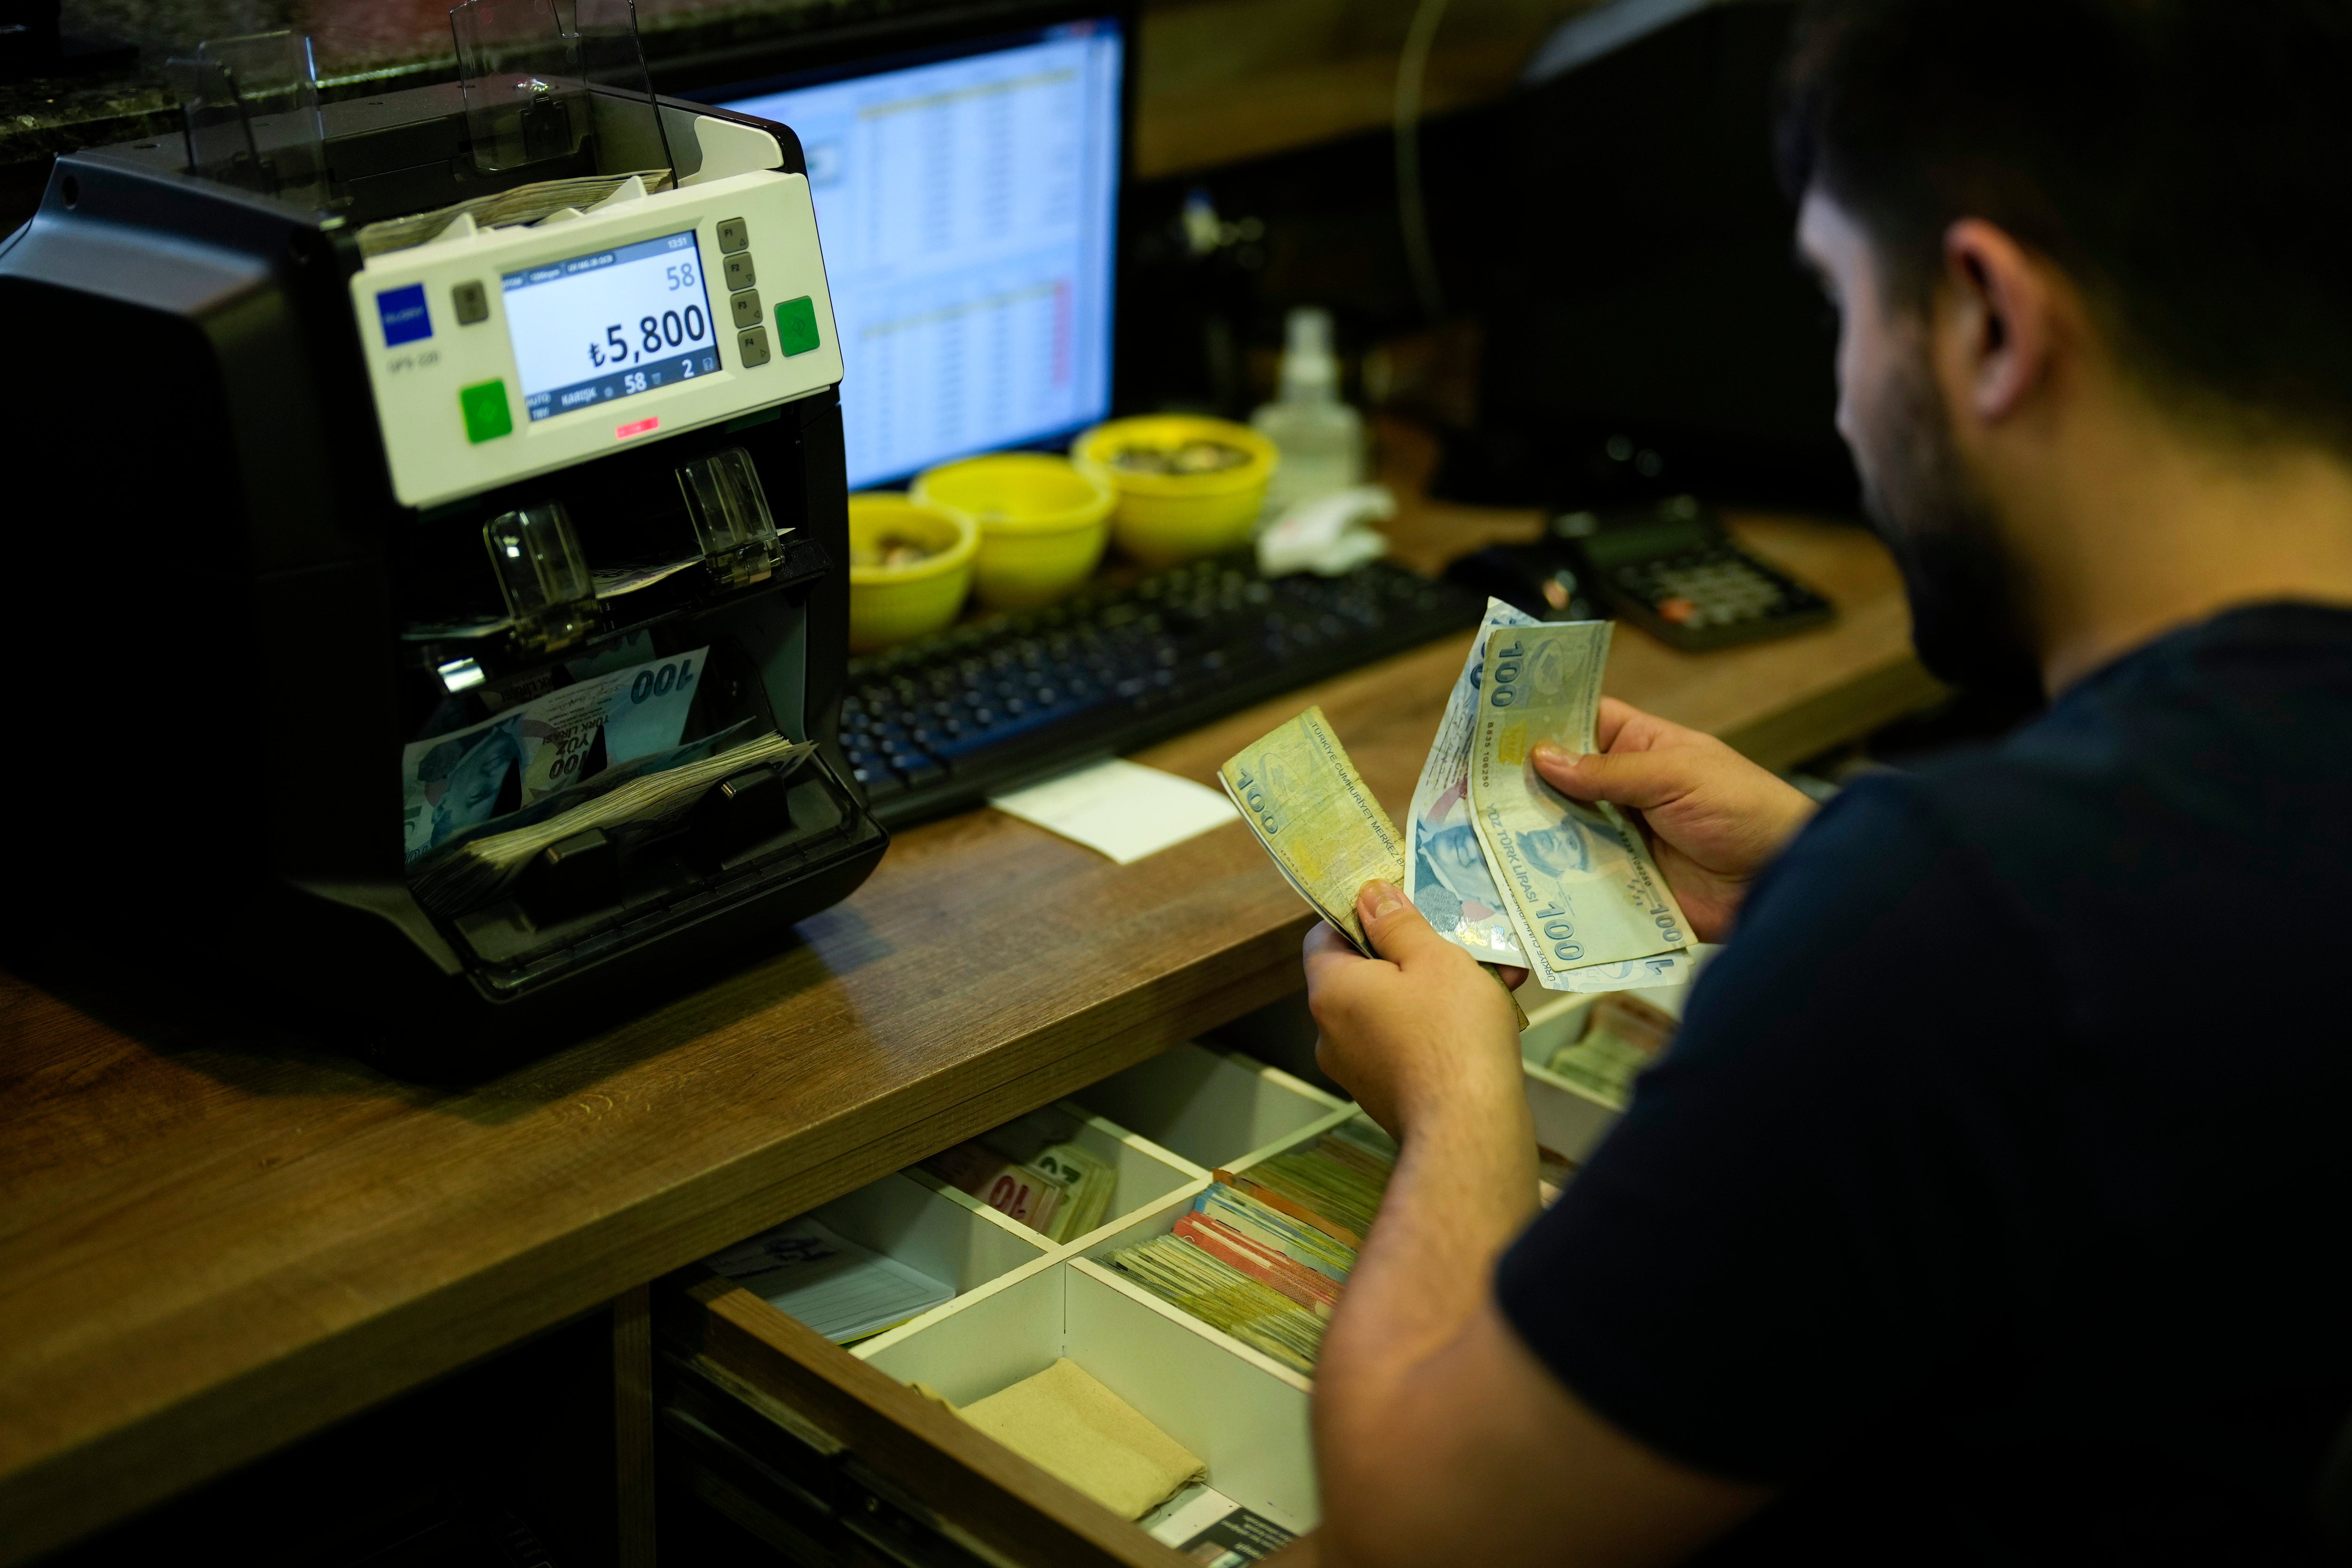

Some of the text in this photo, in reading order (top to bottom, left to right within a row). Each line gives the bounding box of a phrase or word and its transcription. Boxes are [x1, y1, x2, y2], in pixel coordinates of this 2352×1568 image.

[667, 237, 688, 248] 13:51
[724, 228, 733, 237] F1
[666, 262, 695, 291] 58
[731, 263, 740, 272] F2
[738, 301, 747, 310] F3
[745, 338, 754, 347] F4
[624, 371, 648, 395] 58
[681, 359, 695, 378] 2
[630, 658, 694, 705] 100
[1491, 640, 1525, 707] 100
[556, 733, 589, 756] YÜZ
[1236, 768, 1279, 834] 100
[1311, 722, 1338, 762] TÜRKİYE
[1335, 762, 1374, 821] CUMHURİYET
[1370, 821, 1400, 858] MERKEZ
[1486, 801, 1502, 829] YÜZ
[1497, 831, 1521, 863] TÜRK
[1512, 863, 1539, 903] LİRASI
[1535, 901, 1585, 960] 100
[1650, 903, 1683, 942] 100
